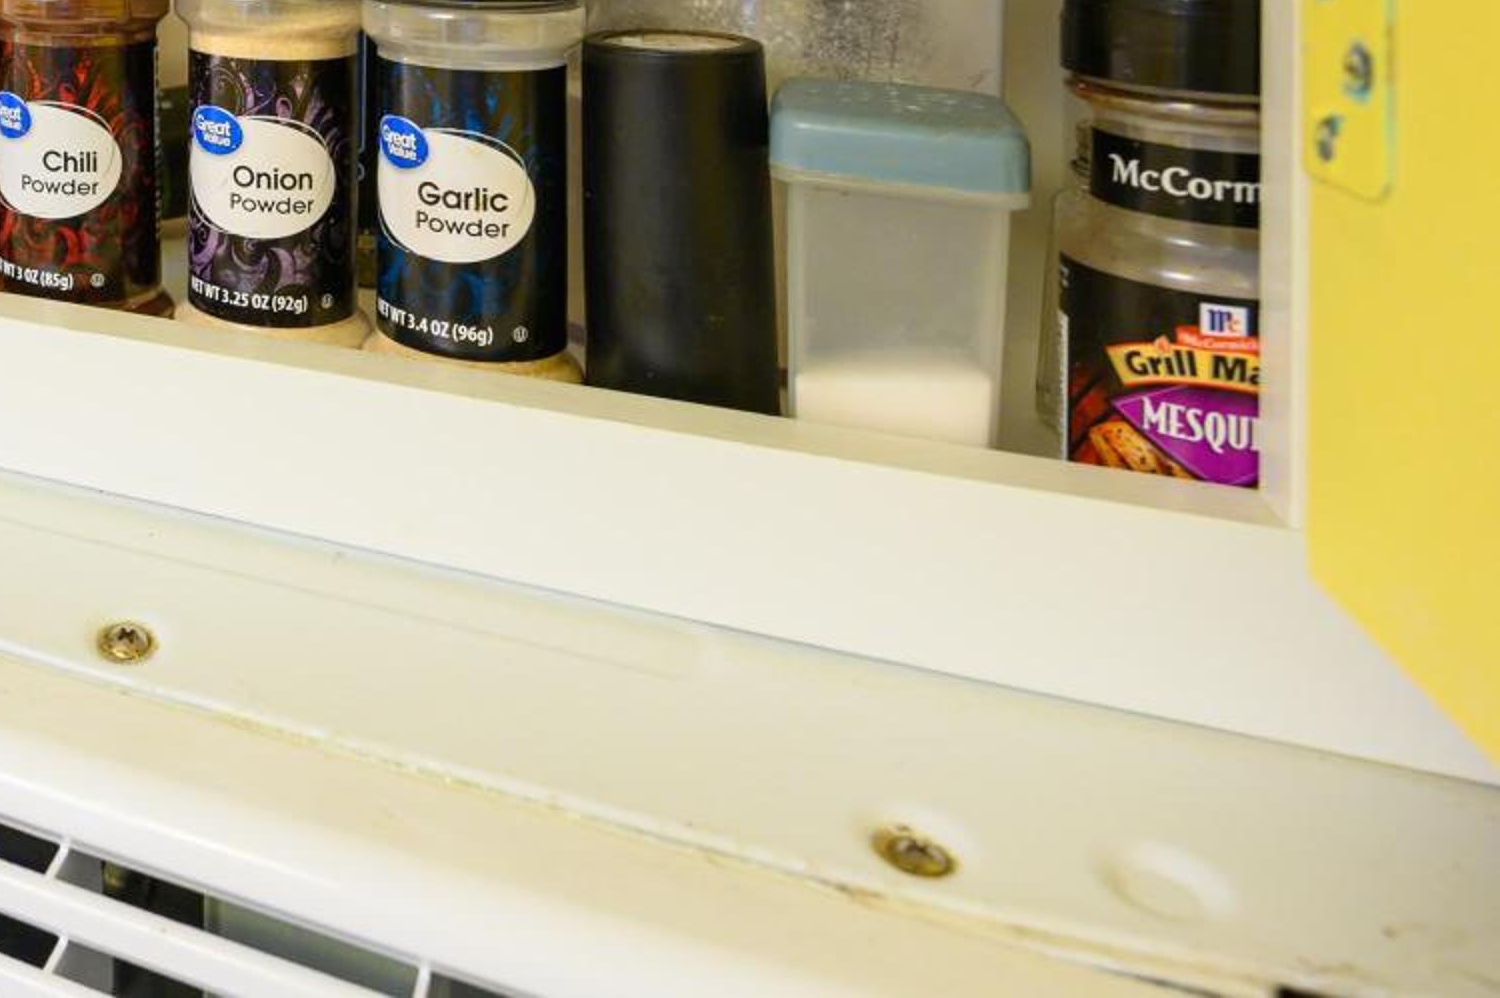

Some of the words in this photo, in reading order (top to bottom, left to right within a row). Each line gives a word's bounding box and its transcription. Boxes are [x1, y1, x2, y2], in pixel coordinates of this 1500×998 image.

[195, 113, 232, 137] Great
[381, 124, 417, 150] Great
[203, 133, 232, 148] Value
[389, 146, 417, 161] Value
[42, 149, 98, 173] Chili
[21, 174, 99, 196] Powder
[233, 165, 314, 191] Onion
[1108, 153, 1260, 204] McCorm
[230, 191, 315, 215] Powder
[417, 181, 509, 213] Garlic
[415, 209, 510, 238] Powder
[3, 261, 16, 279] WT
[15, 265, 23, 281] 3
[23, 267, 40, 285] OZ
[41, 270, 74, 291] (85g)
[191, 274, 204, 295] NET
[204, 282, 221, 301] WT
[221, 288, 249, 307] 3.25
[251, 293, 270, 310] OZ
[271, 295, 308, 314] (92g)
[377, 297, 390, 318] NET
[389, 305, 407, 326] WT
[407, 312, 428, 334] 3.4
[430, 319, 449, 338] OZ
[452, 323, 494, 347] (96g)
[1123, 349, 1197, 378] Grill
[1211, 354, 1260, 386] Ma
